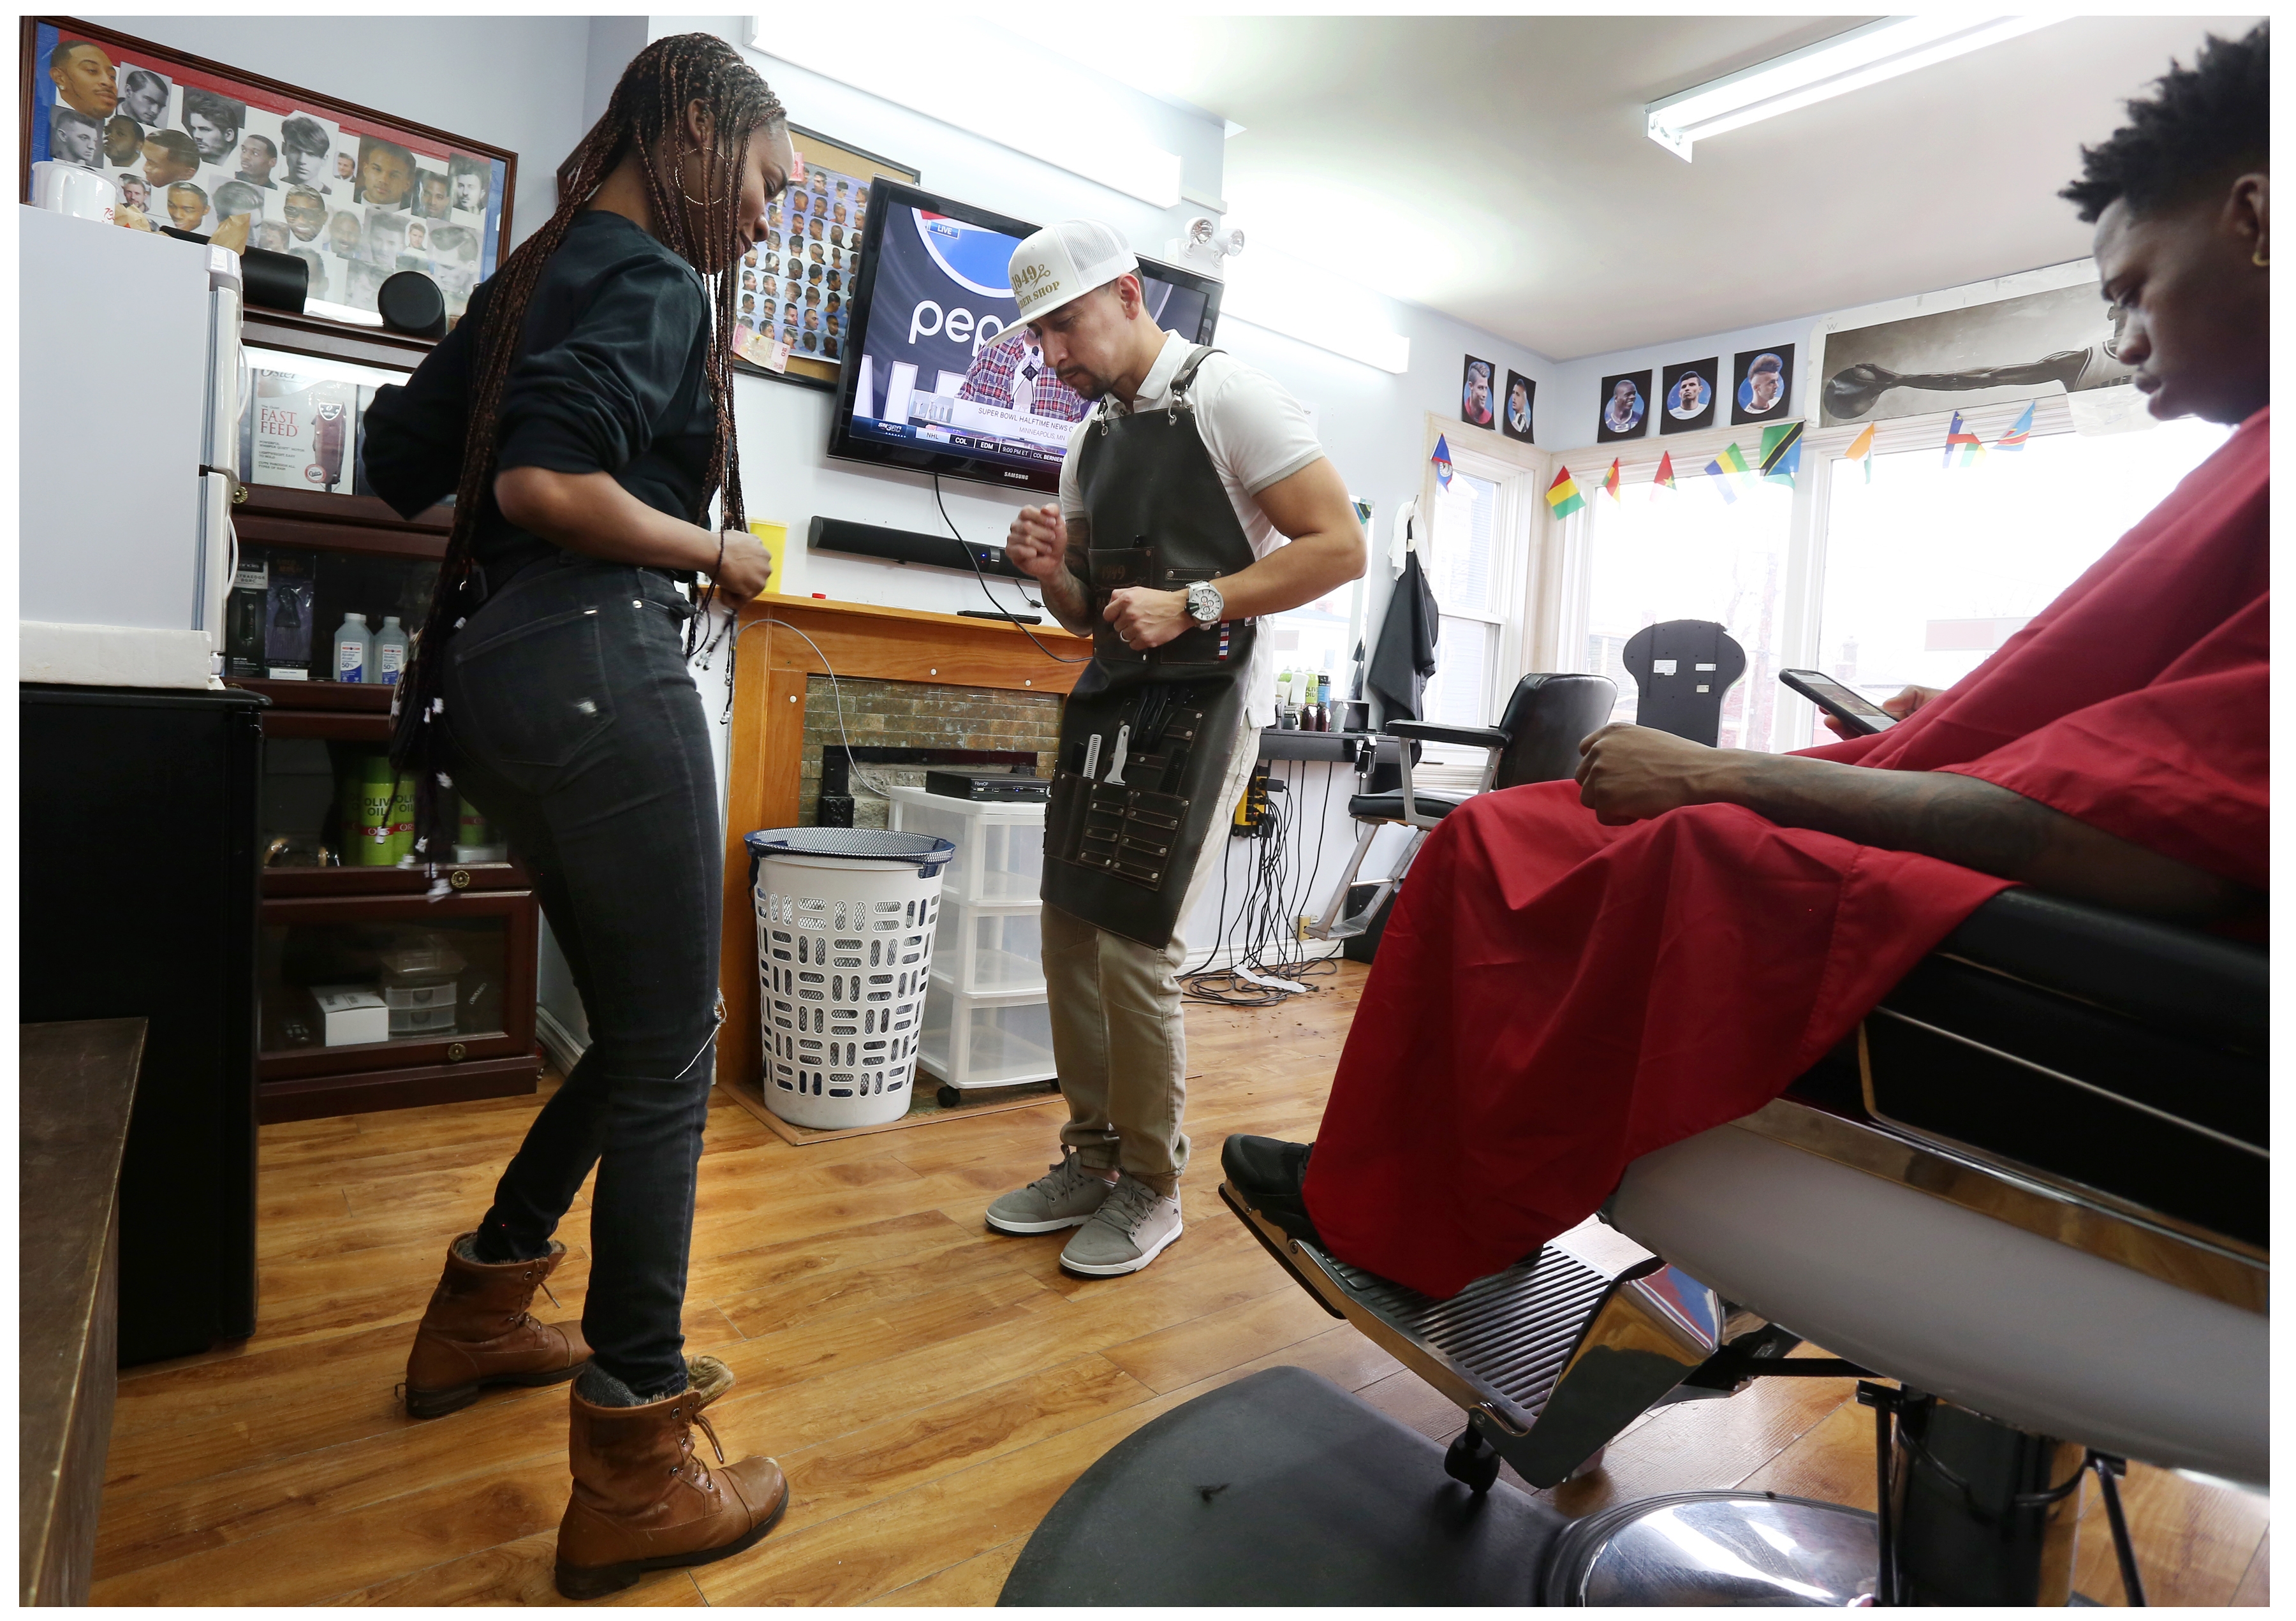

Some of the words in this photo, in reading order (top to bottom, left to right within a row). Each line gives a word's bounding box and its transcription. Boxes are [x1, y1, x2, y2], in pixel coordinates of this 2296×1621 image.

[937, 224, 952, 235] LIVE
[1012, 265, 1037, 290] 1949
[1033, 281, 1059, 300] SHOP
[261, 408, 297, 424] FAST
[978, 407, 999, 417] SUPER
[1000, 413, 1017, 421] BOWL
[1019, 416, 1050, 428] HALFTIME
[1050, 422, 1068, 432] NEWS
[260, 421, 298, 437] FEED
[1019, 427, 1056, 440] MINNEAPOLIS,
[955, 437, 968, 445] COL
[1004, 472, 1029, 480] SAMSUNG
[364, 798, 390, 806] OLIV
[367, 807, 386, 816] OIL
